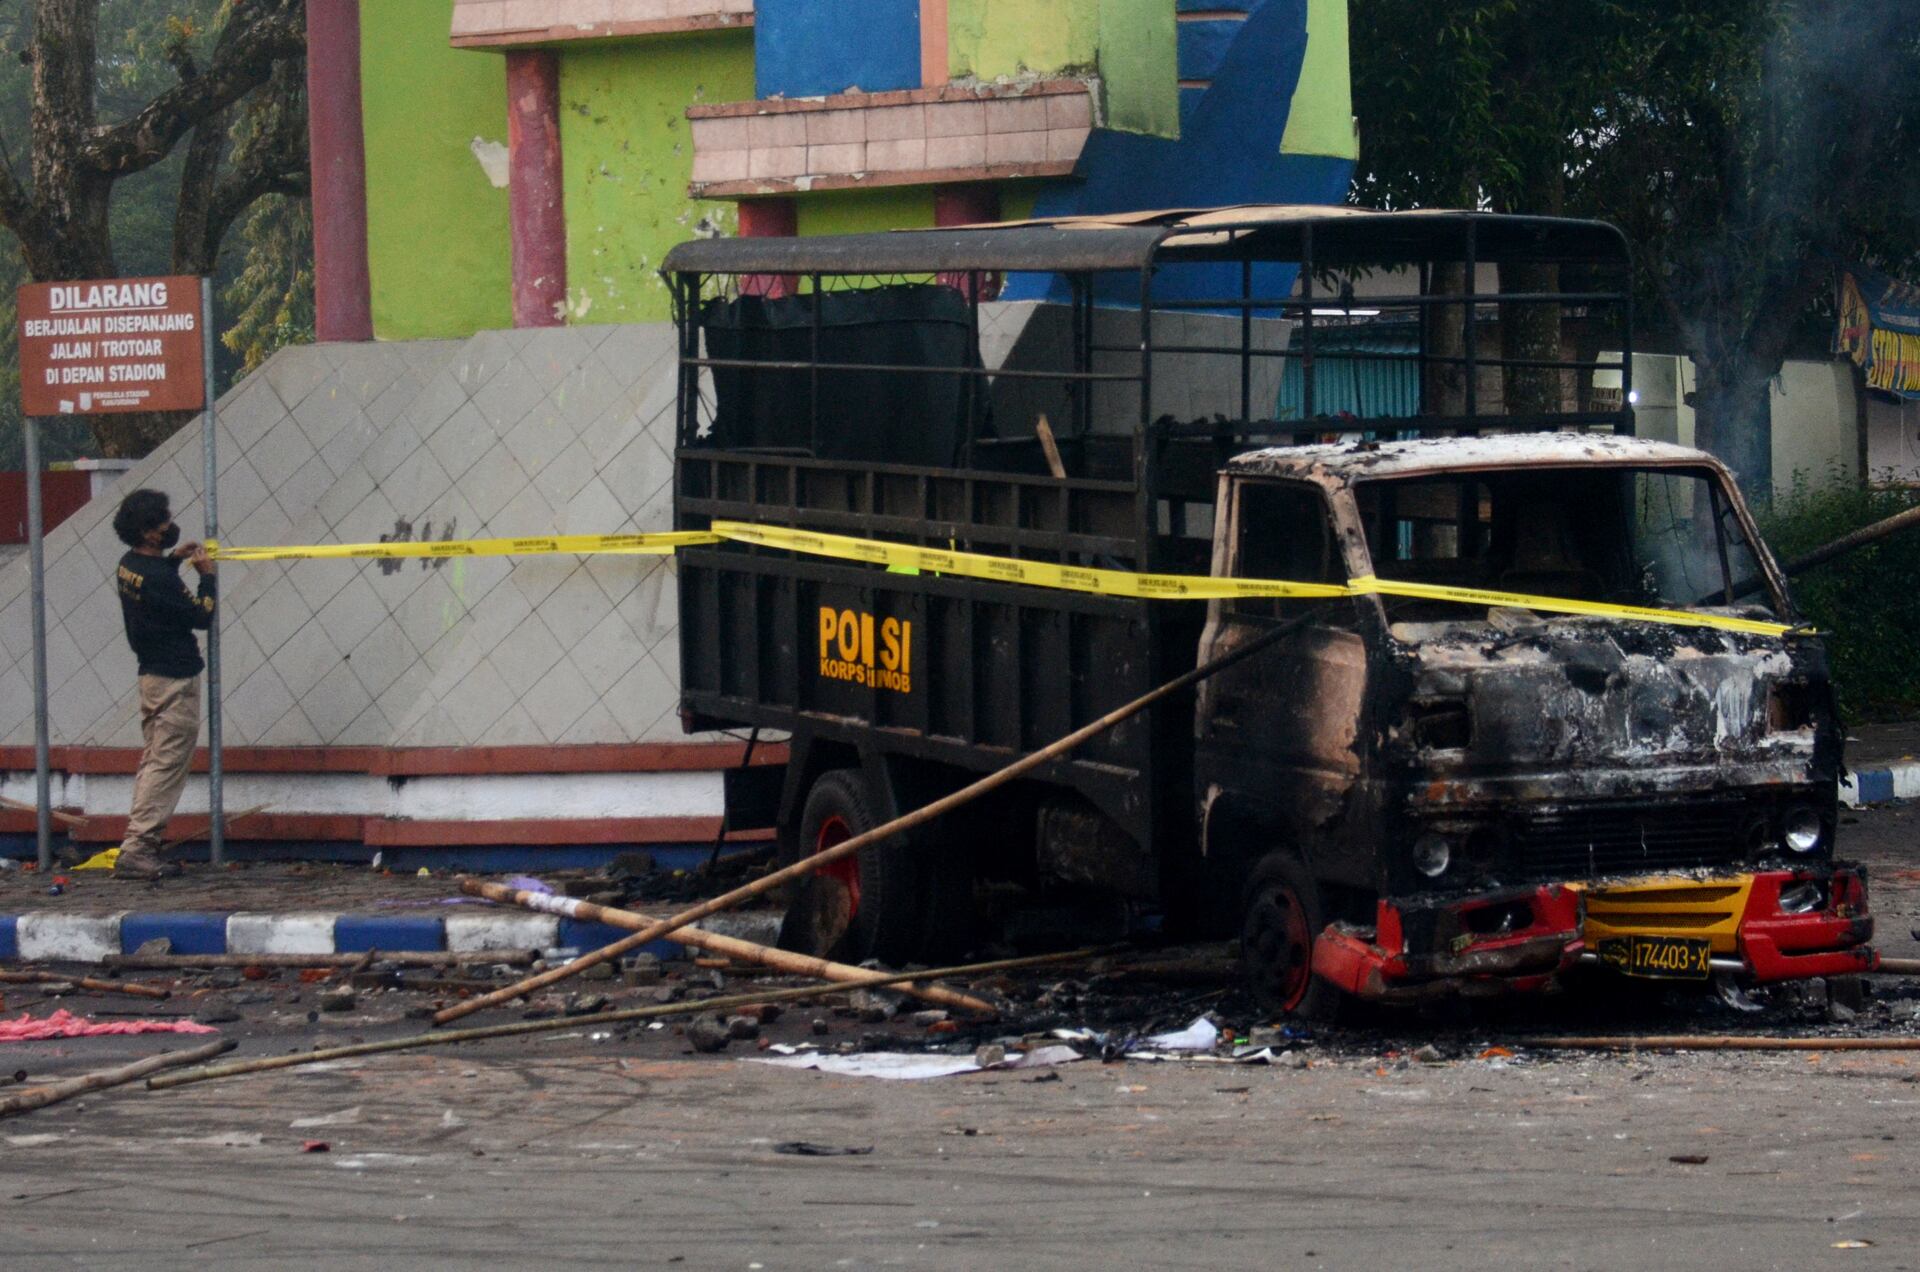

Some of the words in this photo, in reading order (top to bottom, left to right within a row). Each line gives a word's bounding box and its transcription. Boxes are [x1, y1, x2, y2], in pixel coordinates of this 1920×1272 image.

[50, 283, 168, 309] DILARANG
[25, 317, 101, 337] BERJUALAN
[105, 314, 194, 334] DISEPANJANG
[50, 341, 91, 360] JALAN
[93, 341, 99, 358] /
[101, 339, 162, 357] TROTOAR
[46, 368, 59, 385] DI
[63, 366, 104, 384] DEPAN
[109, 363, 166, 381] STADION
[820, 658, 865, 683] KORPS
[1636, 943, 1708, 971] 174403-X
